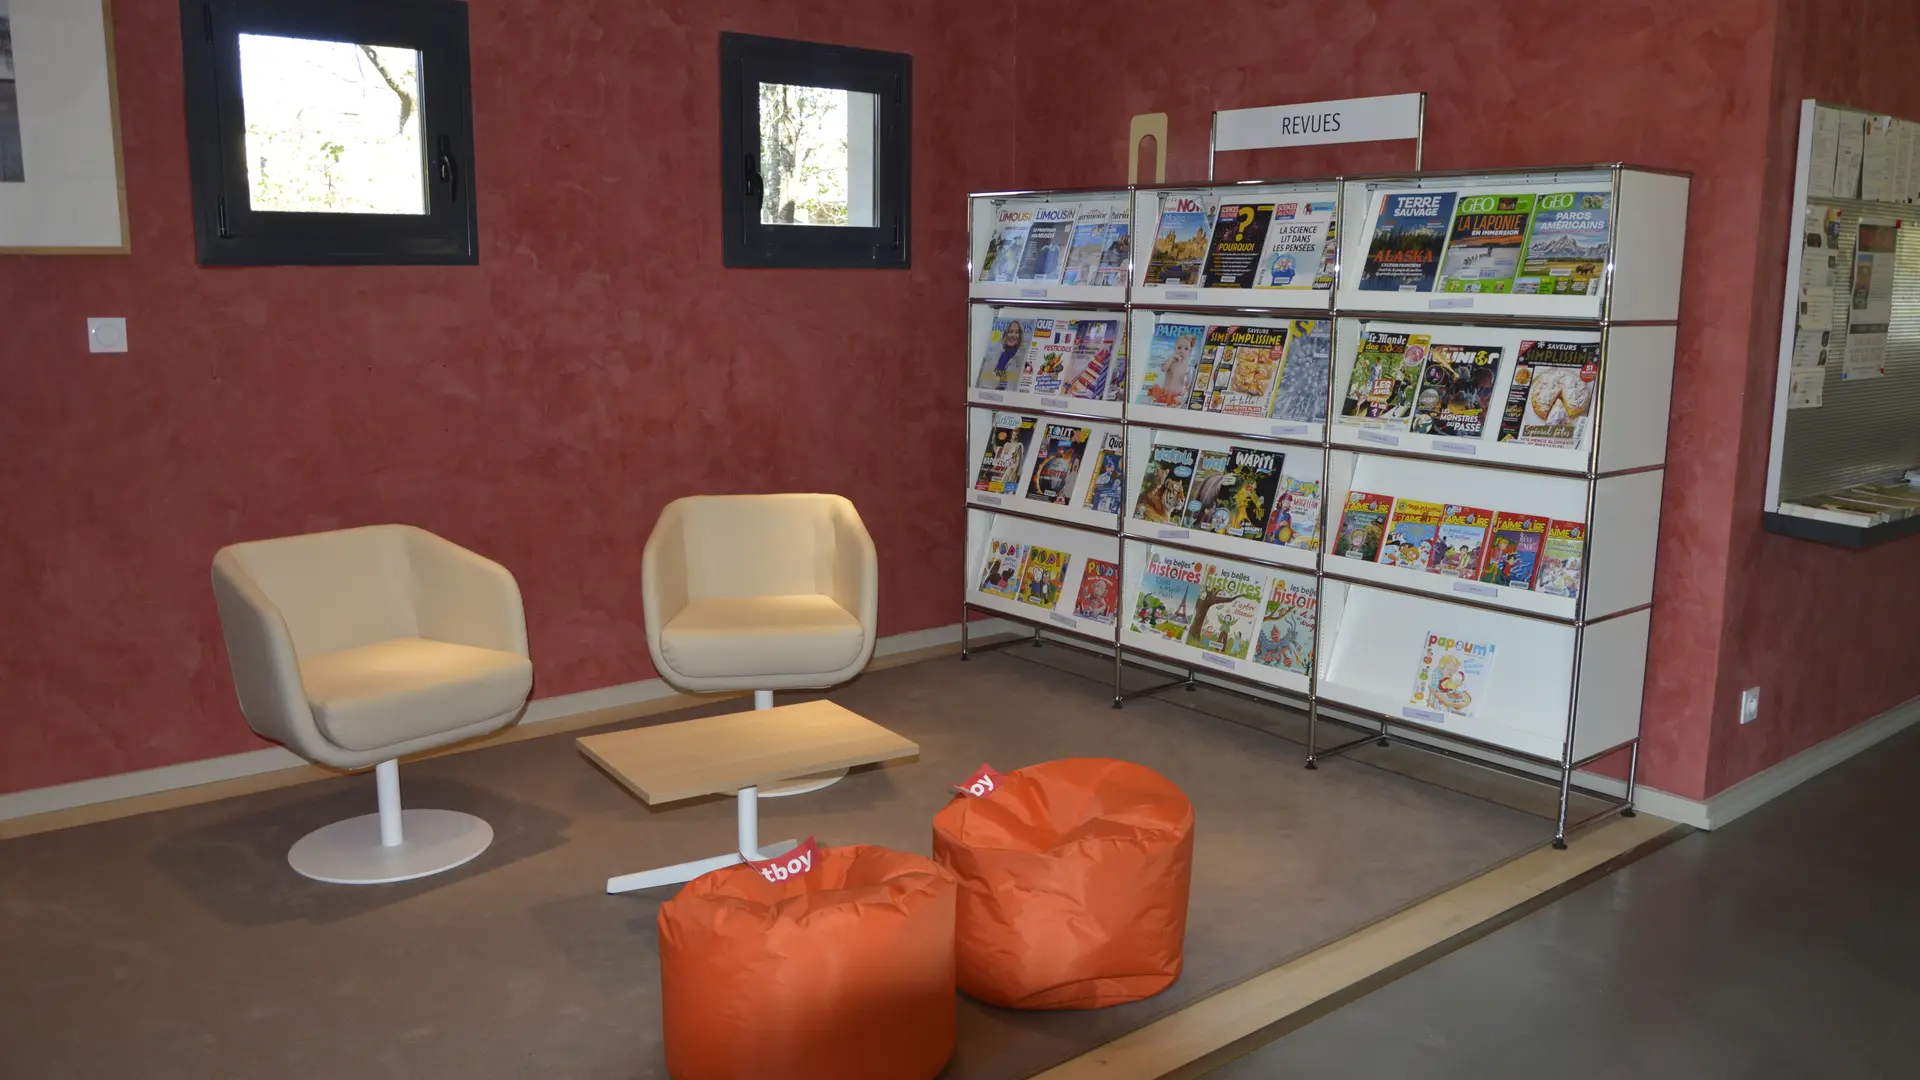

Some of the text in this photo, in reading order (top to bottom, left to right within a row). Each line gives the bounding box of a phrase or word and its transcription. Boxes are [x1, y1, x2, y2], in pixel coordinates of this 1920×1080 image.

[1282, 112, 1341, 135] REVUES
[1177, 199, 1201, 213] NO
[1397, 196, 1442, 209] TERRE
[1461, 196, 1495, 213] GEO
[1541, 193, 1574, 209] GEO
[1393, 208, 1439, 217] SAUVAGE
[1556, 211, 1592, 221] PARCS
[1456, 214, 1523, 231] LA LAPONIE
[1540, 219, 1605, 231] AMÉRICAINS
[1279, 225, 1318, 235] LA SCIENCE
[1280, 235, 1311, 244] LIT DANS
[1218, 243, 1255, 252] POURQUOI
[1272, 244, 1285, 252] LES
[1373, 249, 1433, 263] ALASKA
[1036, 319, 1054, 331] QUE
[1155, 324, 1203, 338] PARENTS
[1247, 327, 1269, 335] SAVEURS
[1230, 332, 1282, 346] SIMPLISSIME
[1367, 333, 1407, 346] Le Monde
[1365, 343, 1379, 351] des
[1547, 343, 1577, 352] SAVEURS
[1525, 350, 1595, 364] SIMPLISSIME
[1374, 380, 1392, 389] LES
[1373, 388, 1391, 396] AMIS
[1440, 413, 1479, 423] MONSTRES
[1048, 425, 1074, 438] TOUT
[1453, 421, 1482, 433] PASSÉ
[1524, 425, 1552, 438] Spécial
[1164, 557, 1191, 569] les belles
[1147, 559, 1201, 585] histoires
[1221, 569, 1250, 582] les belles
[1205, 574, 1261, 596] histoires
[1290, 583, 1300, 593] les
[1427, 634, 1487, 657] papoum
[761, 849, 812, 883] tboy
